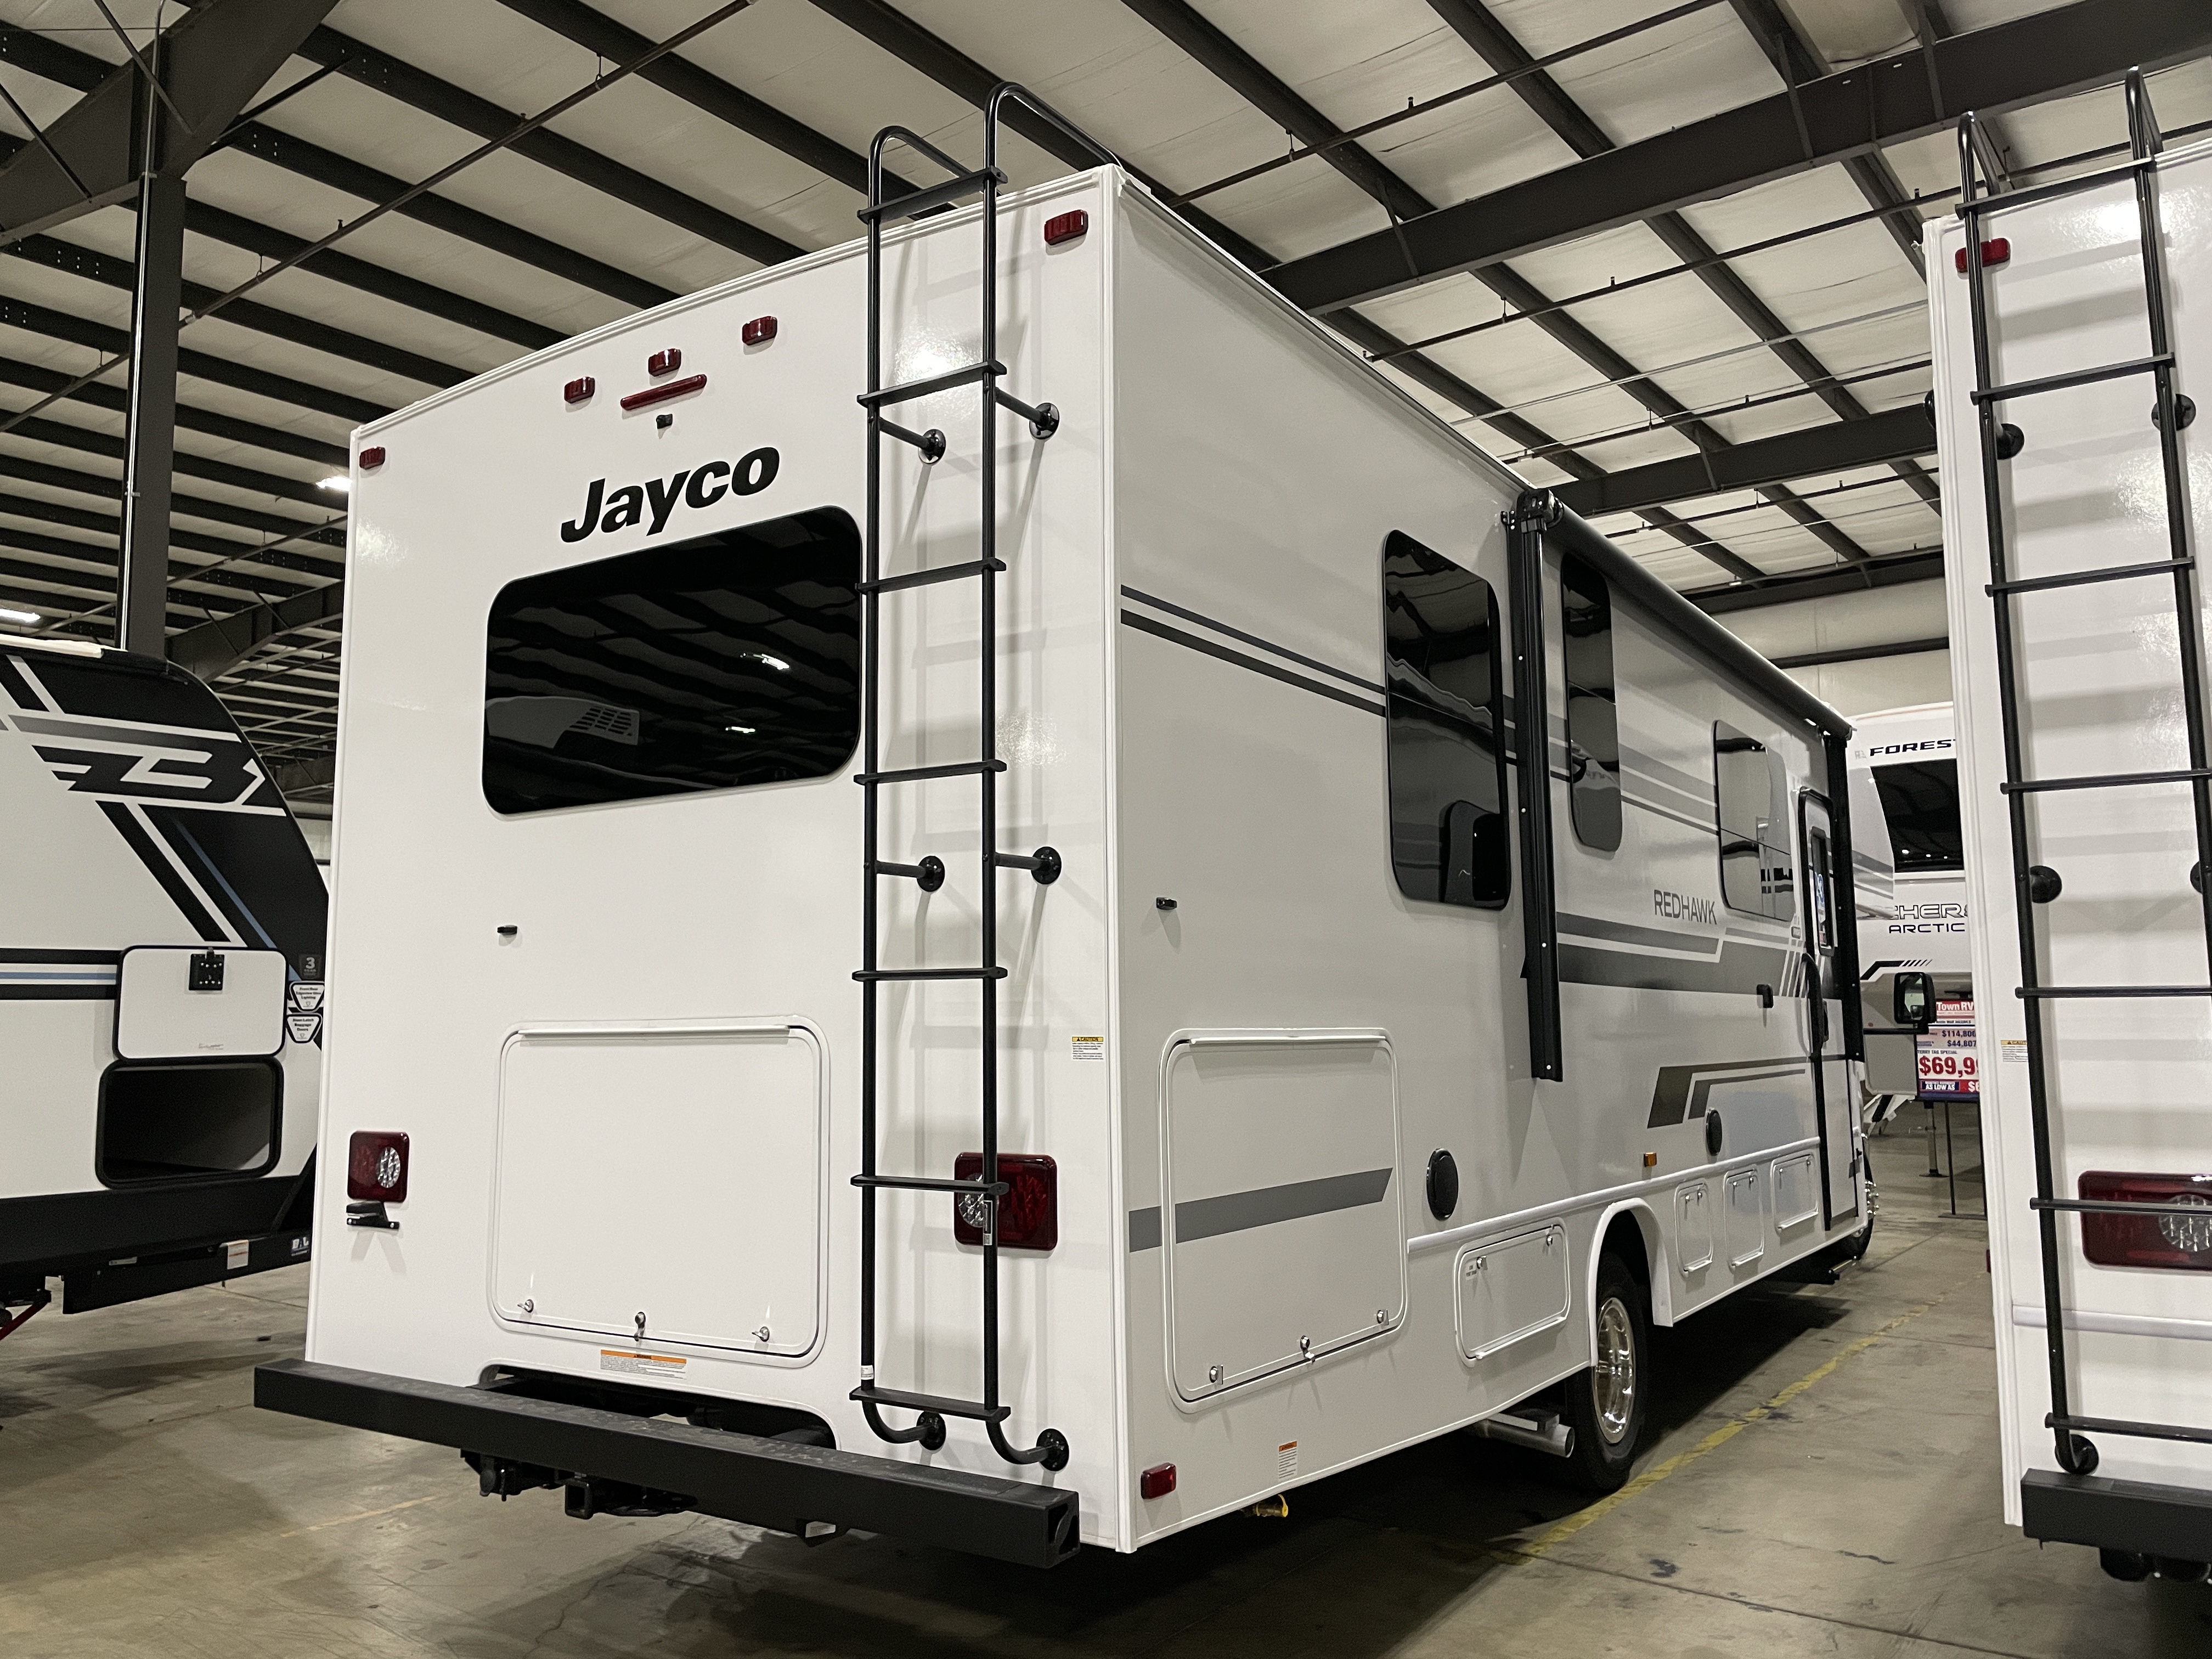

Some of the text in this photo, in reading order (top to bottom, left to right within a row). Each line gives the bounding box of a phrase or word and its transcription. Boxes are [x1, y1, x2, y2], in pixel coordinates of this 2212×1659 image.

[560, 447, 780, 543] Jayco
[1869, 738, 1956, 757] FORES
[1654, 889, 1717, 925] REDHAWK
[1894, 904, 1968, 920] HER
[1889, 923, 1965, 934] ARCTIC
[306, 957, 315, 969] 3
[1936, 1002, 1974, 1011] Town RV
[1919, 1055, 1979, 1078] $69,9
